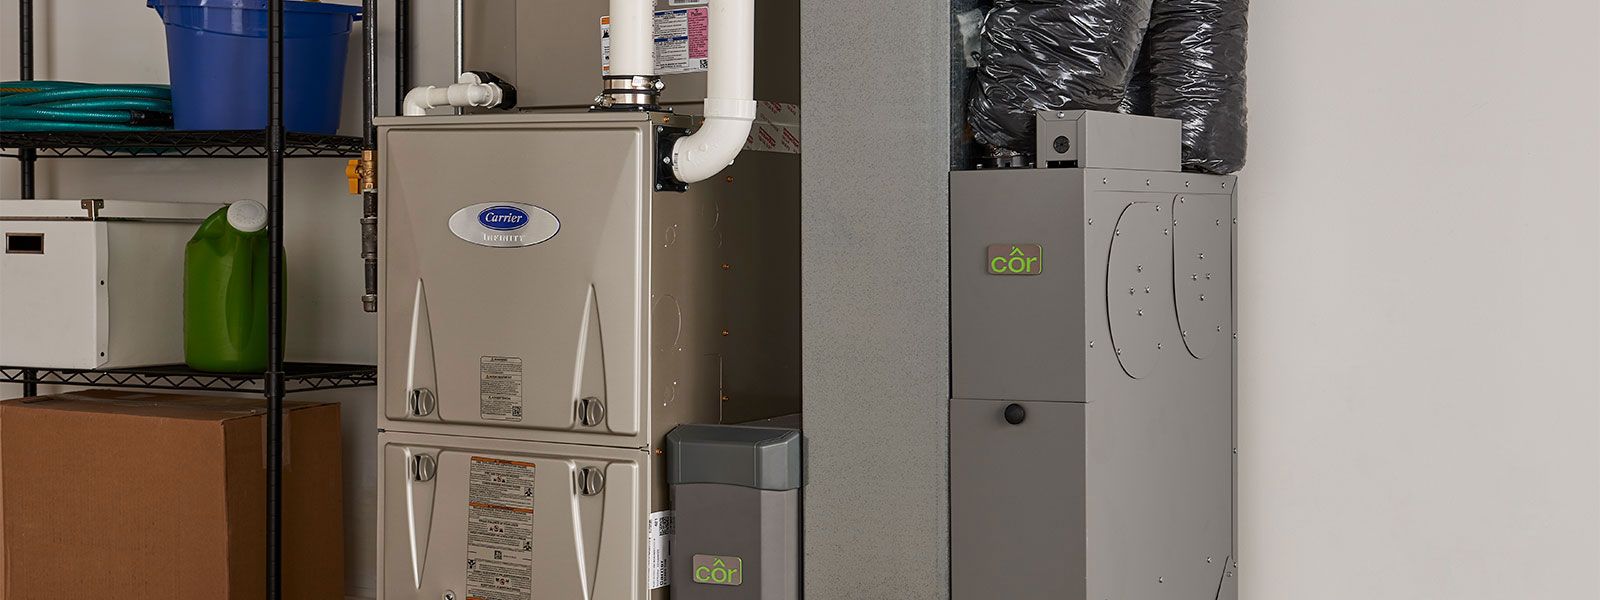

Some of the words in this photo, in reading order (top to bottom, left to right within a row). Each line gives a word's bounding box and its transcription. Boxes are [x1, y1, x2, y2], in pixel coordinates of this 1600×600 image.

[485, 212, 523, 223] Carrier
[483, 233, 525, 242] INFINITY
[991, 246, 1038, 273] côr
[696, 558, 737, 583] côr
